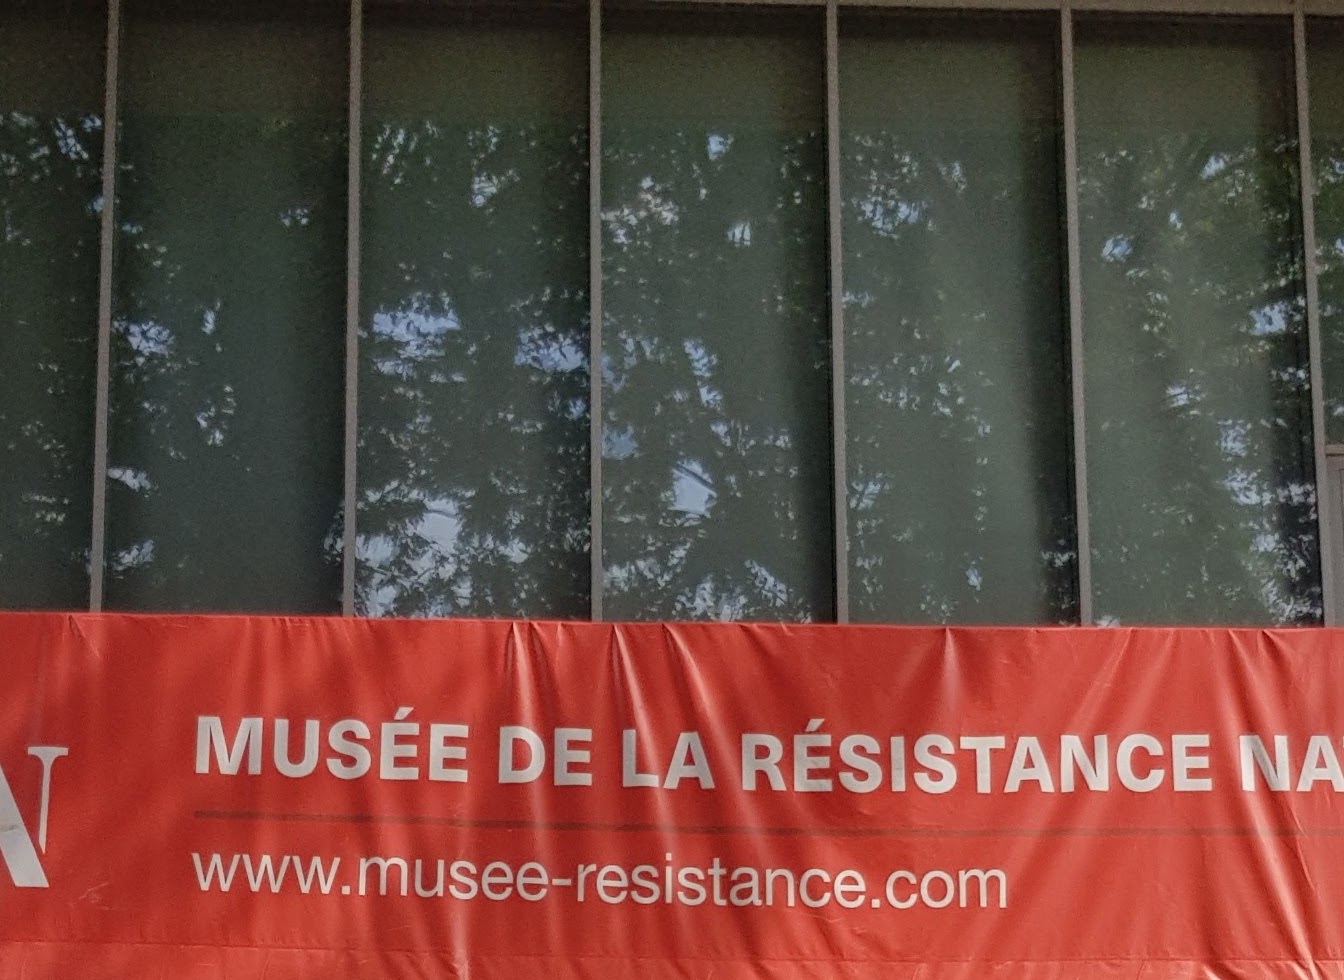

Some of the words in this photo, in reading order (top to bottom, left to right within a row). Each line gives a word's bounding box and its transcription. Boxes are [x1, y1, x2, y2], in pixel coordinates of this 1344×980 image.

[194, 706, 470, 783] MUSÉE
[497, 725, 594, 787] DE
[621, 728, 715, 791] LA
[740, 718, 1214, 795] RÉSISTANCE
[191, 851, 1008, 909] www.musee-resistance.com
